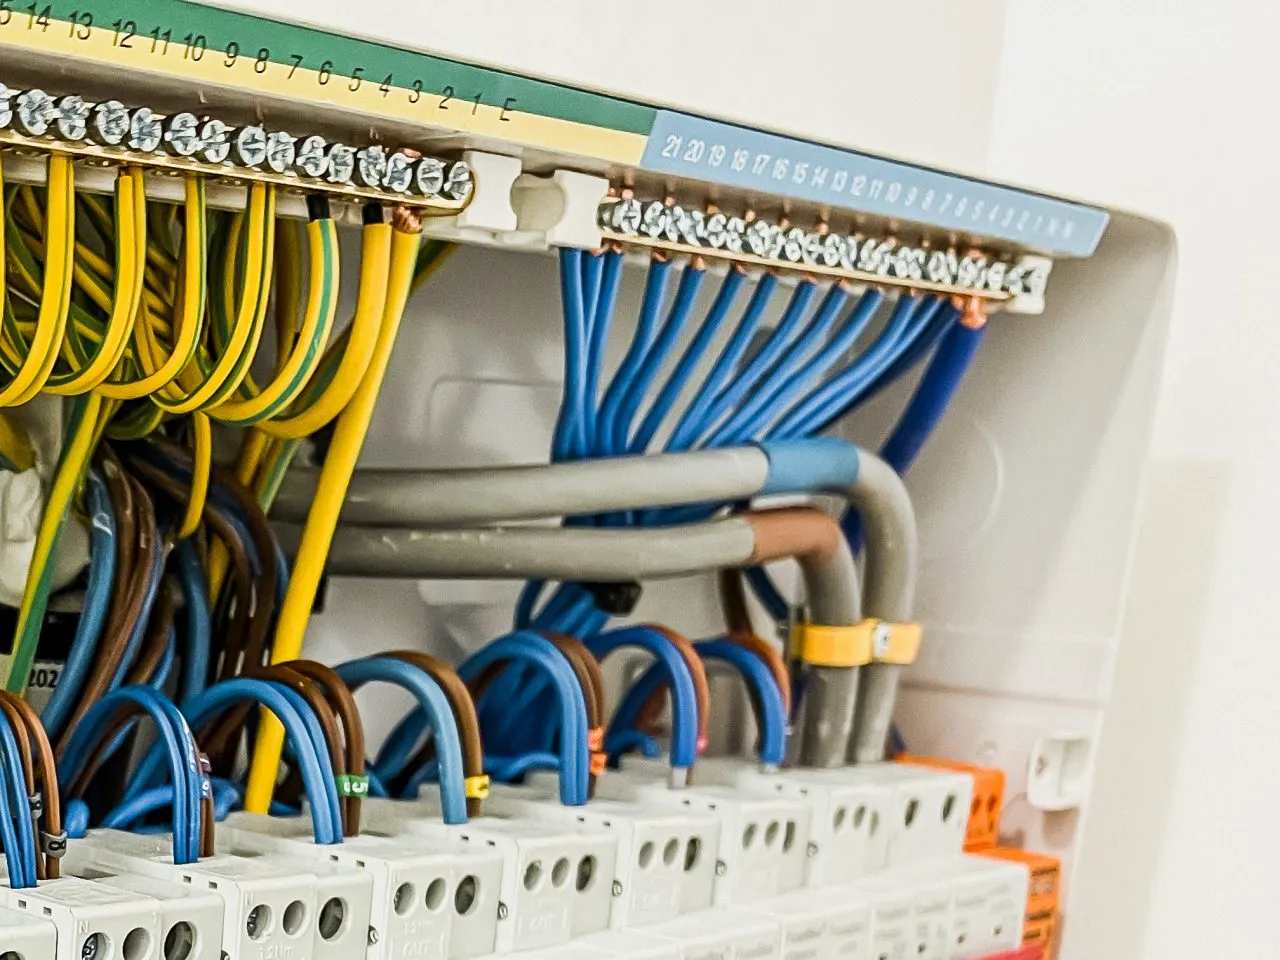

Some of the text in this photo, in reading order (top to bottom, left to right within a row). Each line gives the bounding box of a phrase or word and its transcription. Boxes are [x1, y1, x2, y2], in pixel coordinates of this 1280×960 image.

[27, 3, 51, 32] 14
[69, 11, 93, 40] 13
[112, 18, 136, 48] 12
[150, 26, 173, 55] 11
[184, 33, 207, 61] 10
[224, 41, 239, 67] 9
[254, 48, 270, 73] 8
[287, 54, 303, 79] 7
[319, 60, 333, 85] 6
[348, 67, 364, 91] 5
[378, 73, 393, 97] 4
[408, 79, 423, 103] 3
[438, 85, 454, 109] 2
[471, 92, 482, 115] 1
[500, 98, 516, 120] E
[662, 134, 683, 158] 21
[684, 139, 705, 163] 20
[708, 144, 726, 167] 19
[730, 149, 749, 171] 18
[752, 154, 770, 175] 17
[772, 158, 790, 180] 16
[792, 161, 810, 184] 15
[811, 165, 829, 187] 14
